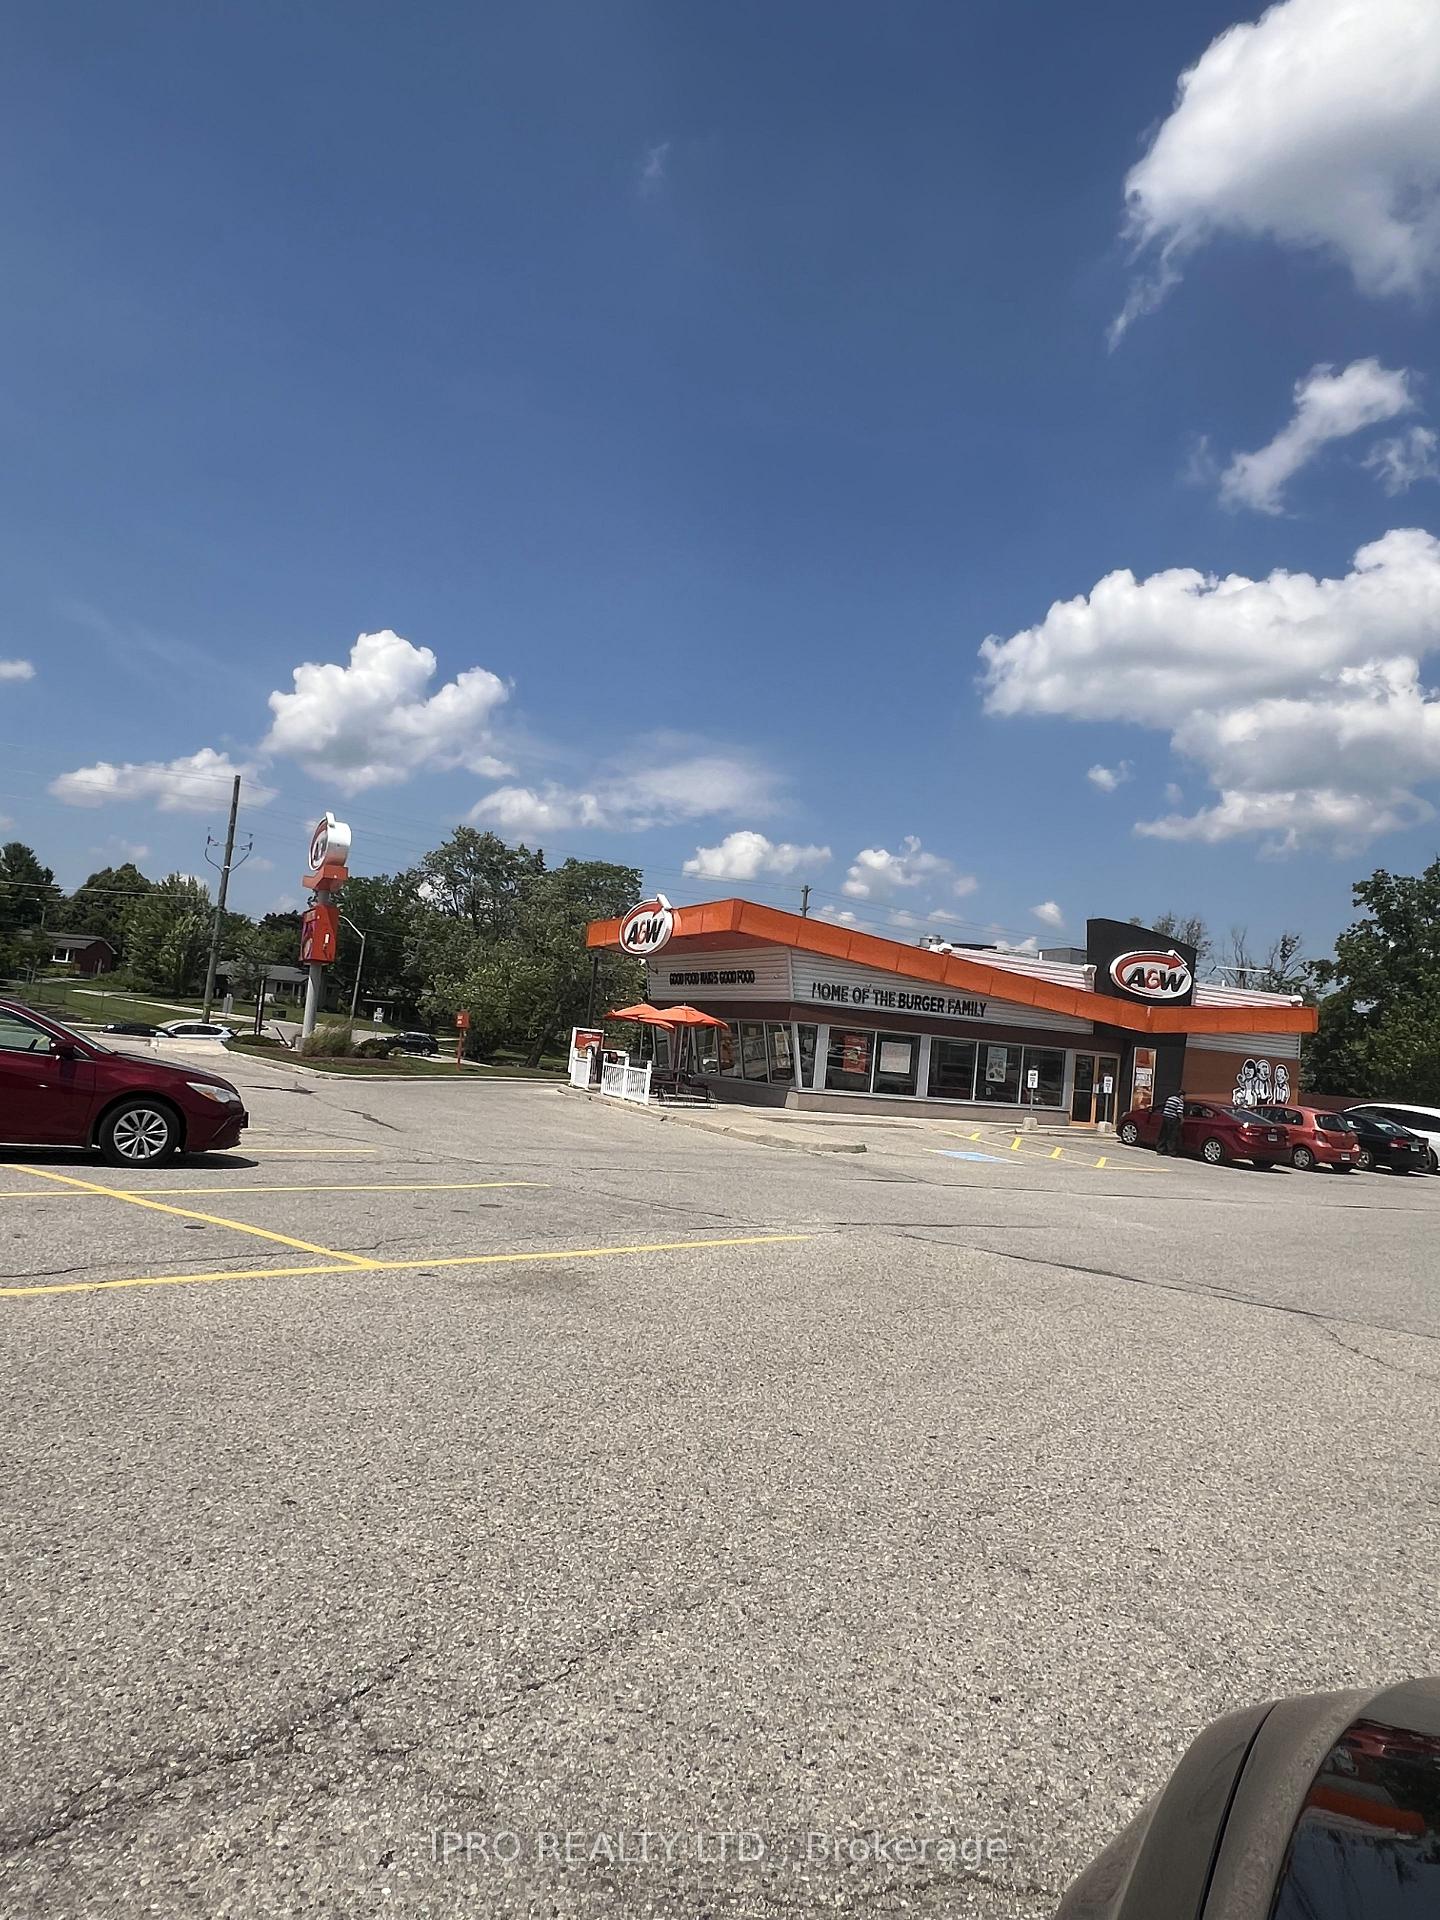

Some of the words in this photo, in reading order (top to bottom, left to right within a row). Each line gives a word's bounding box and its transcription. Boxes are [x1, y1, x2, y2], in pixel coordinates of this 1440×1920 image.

[627, 918, 665, 946] A&W
[1126, 966, 1187, 992] A&W
[812, 982, 848, 1002] HOME
[852, 986, 869, 1004] OF
[873, 989, 896, 1008] THE
[898, 992, 945, 1013] BURGER
[947, 998, 987, 1018] FAMILY
